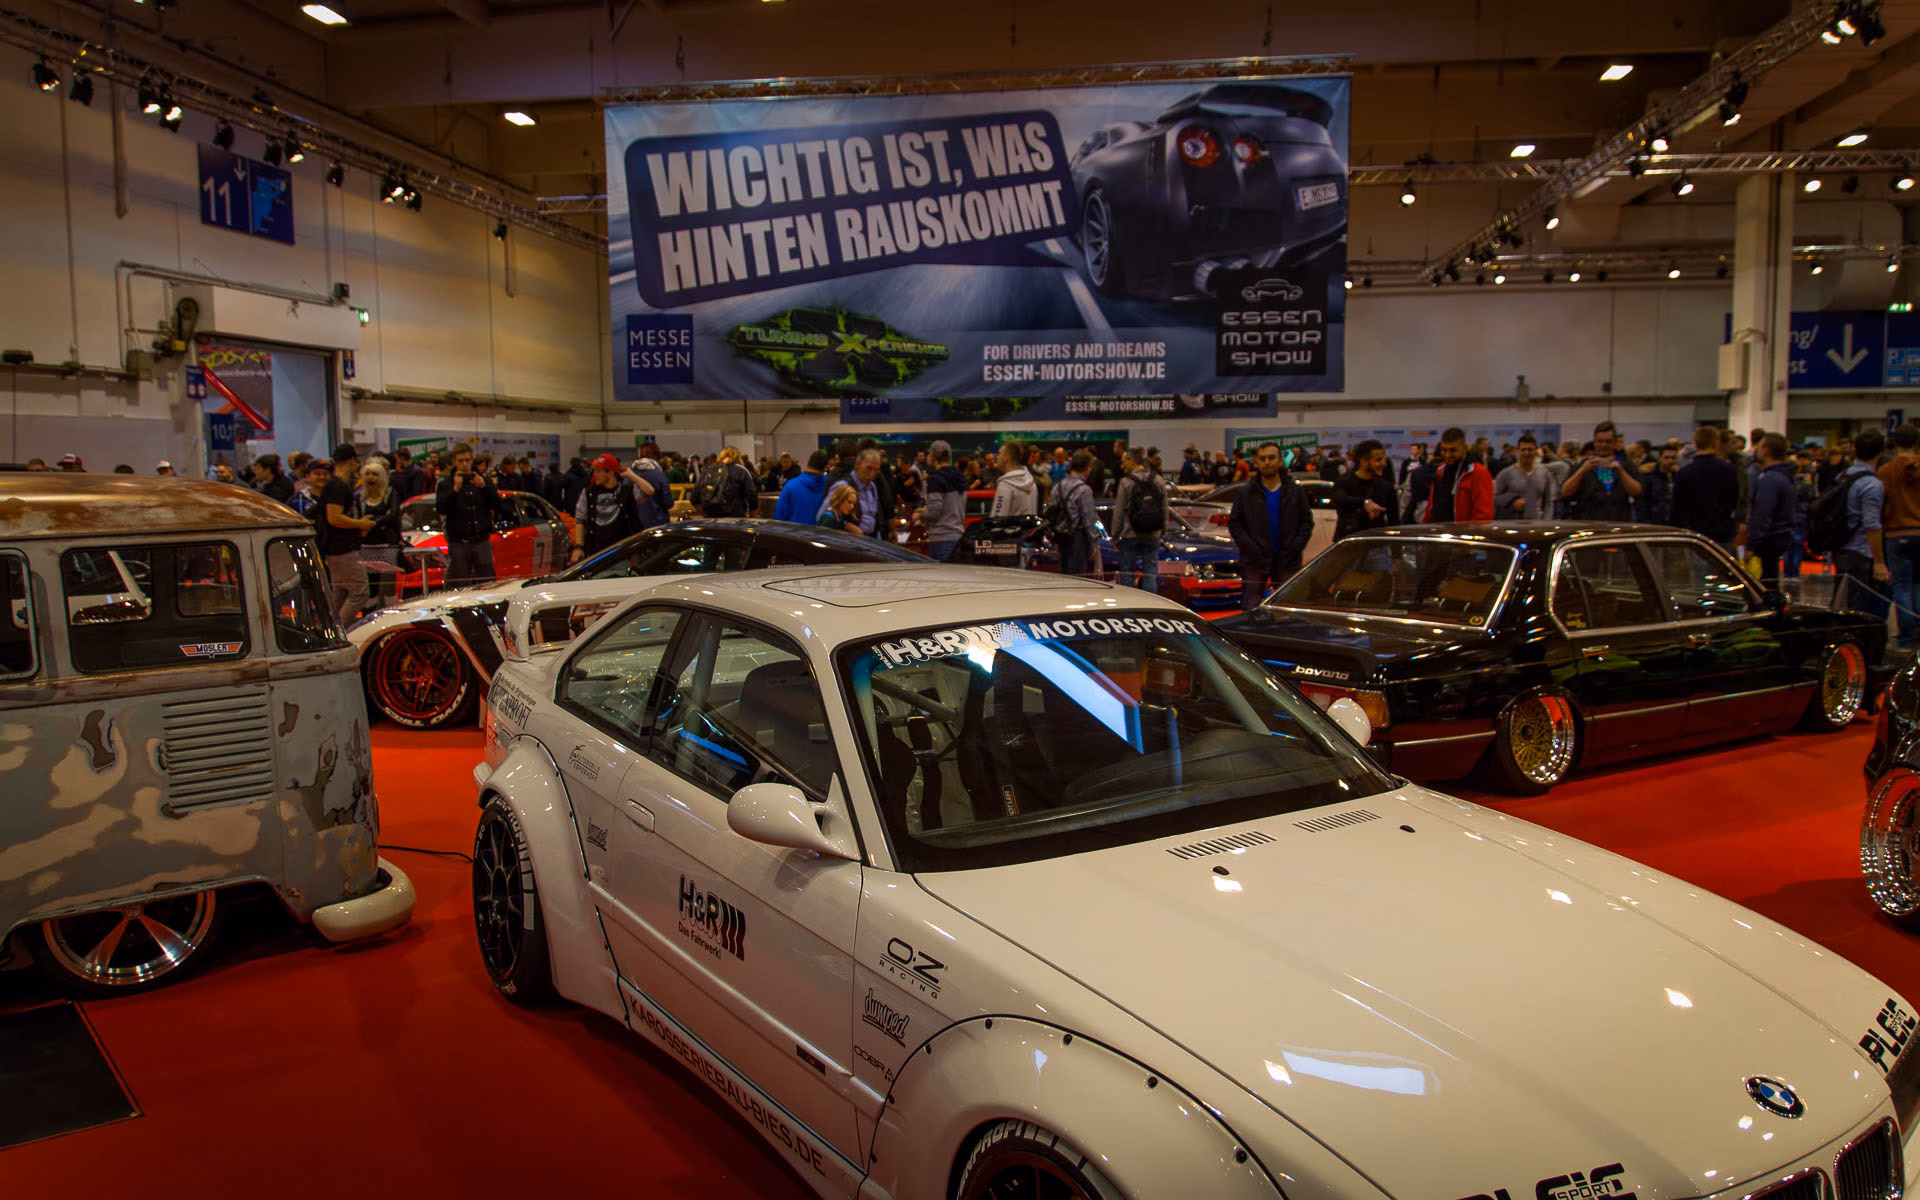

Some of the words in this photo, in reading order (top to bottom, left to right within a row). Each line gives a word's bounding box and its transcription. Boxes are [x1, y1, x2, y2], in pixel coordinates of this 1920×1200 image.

[646, 136, 880, 218] WICHTIG
[883, 129, 964, 188] IST,
[961, 121, 1055, 180] WAS
[203, 176, 233, 226] 11
[657, 211, 830, 293] HINTEN
[834, 180, 1067, 263] RAUSKOMMT
[1221, 310, 1323, 327] ESSEN
[629, 329, 690, 346] MESSE
[739, 325, 830, 347] TUNING
[1221, 331, 1323, 346] MOTOR
[629, 351, 690, 369] ESSEN
[983, 345, 1009, 360] FOR
[1013, 343, 1071, 360] DRIVERS
[1074, 342, 1104, 358] AND
[1107, 341, 1166, 358] DREAMS
[1230, 351, 1313, 366] SHOW
[983, 361, 1166, 382] ESSEN-MOTORSHOW.DE
[1065, 400, 1175, 412] ESSEN-MOTORSHOW.DE
[1028, 616, 1202, 641] MOTORSPORT
[196, 643, 228, 652] MOSLER
[879, 959, 938, 1000] RACING
[863, 987, 910, 1041] dumped
[629, 995, 827, 1178] KAROSSERIEBAU-BIES.DE
[1555, 1180, 1611, 1200] SPORT
